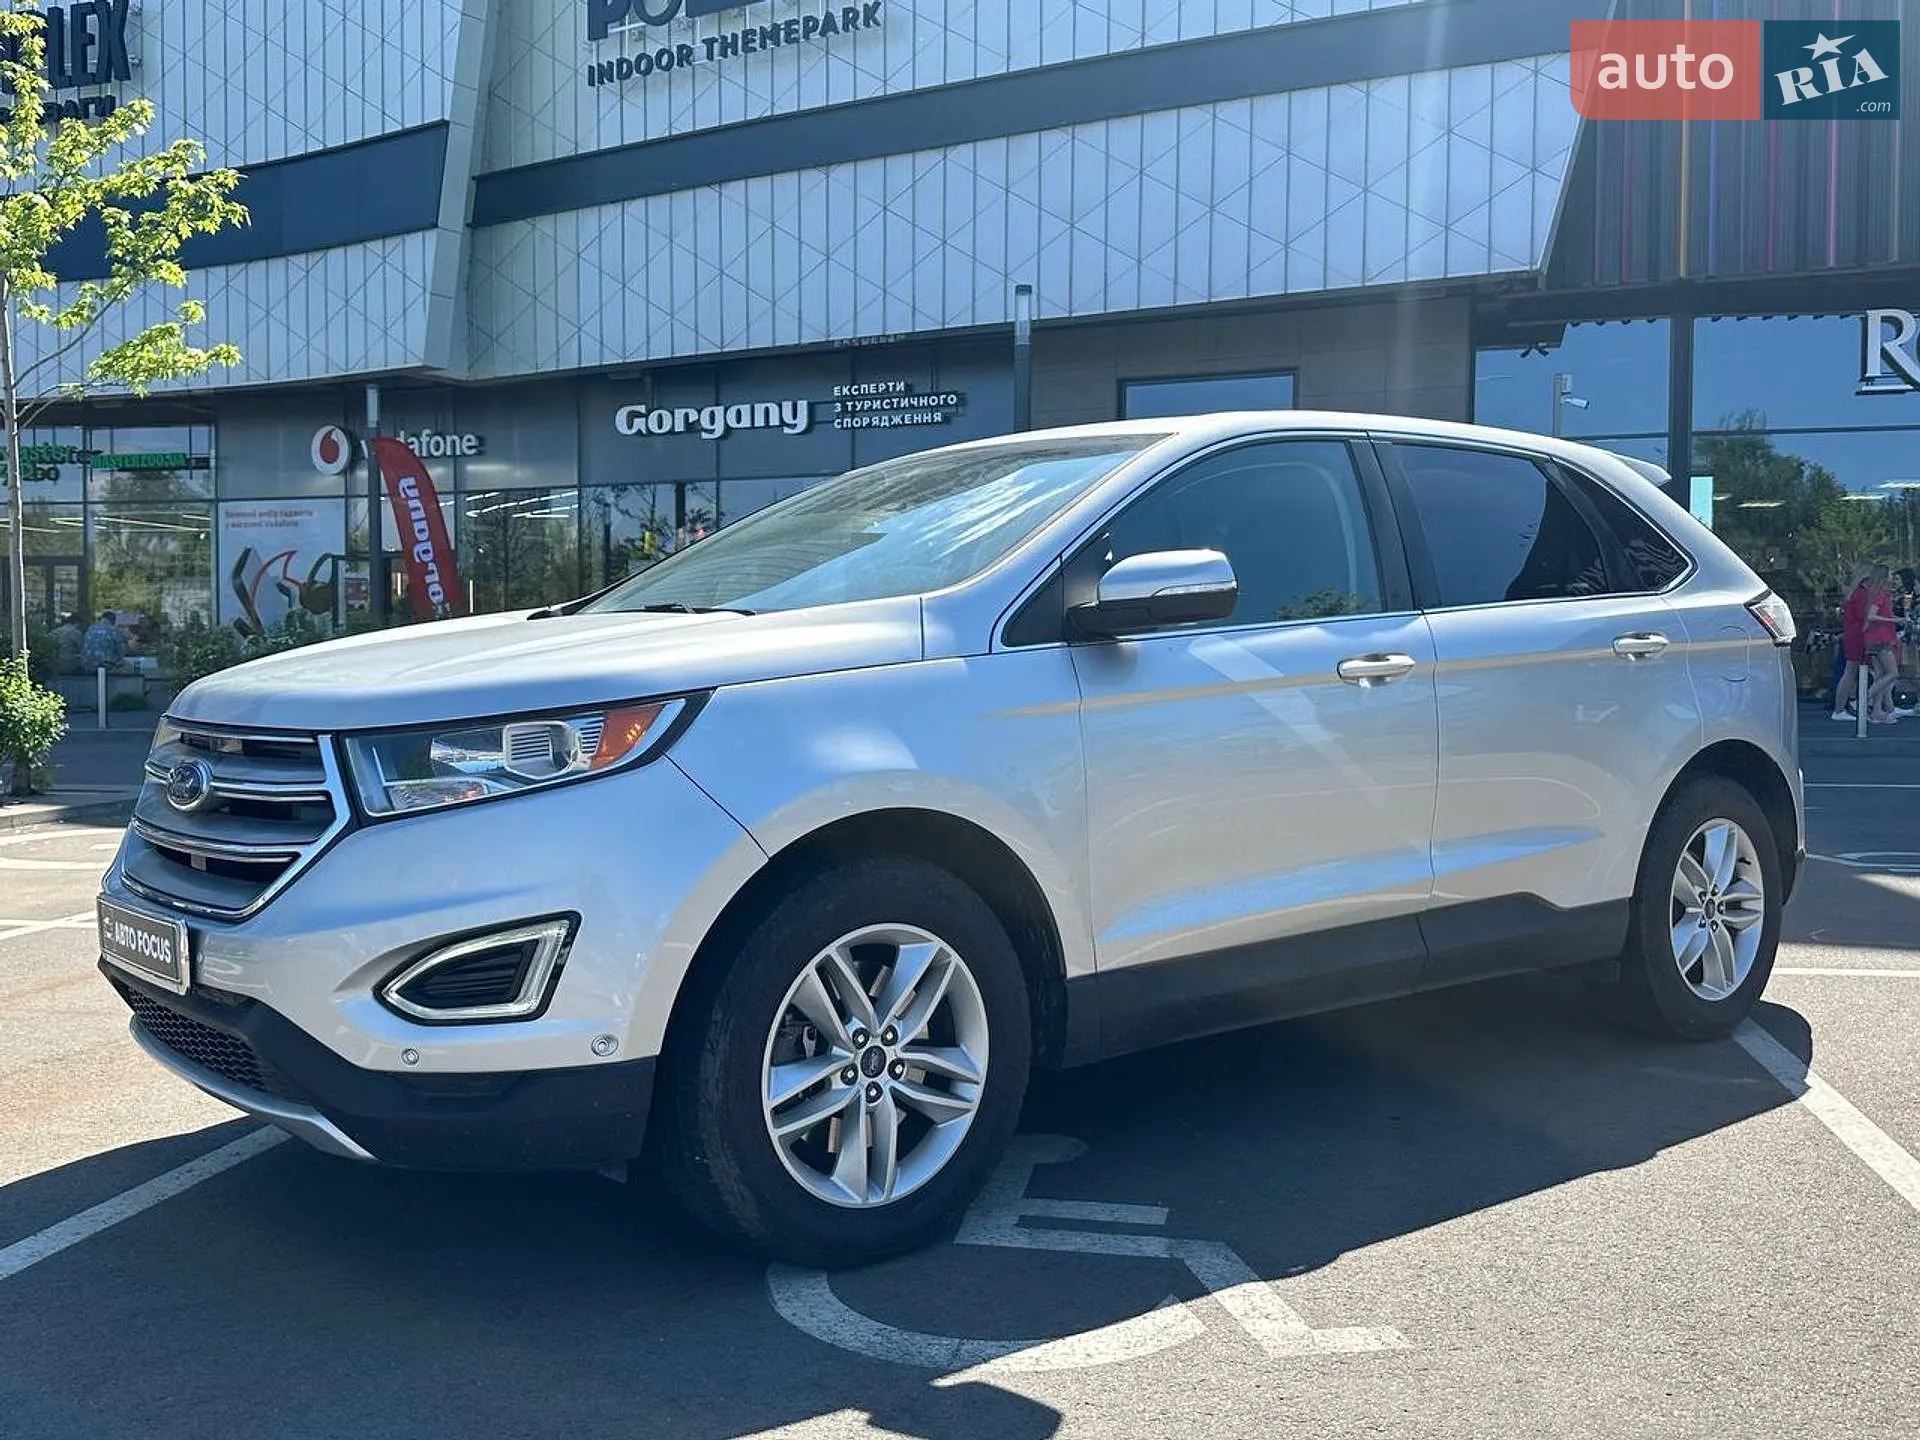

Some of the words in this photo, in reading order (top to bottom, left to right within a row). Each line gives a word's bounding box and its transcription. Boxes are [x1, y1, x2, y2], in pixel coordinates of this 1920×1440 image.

[587, 43, 693, 87] INDOOR
[702, 1, 882, 61] THEMEPARK
[1862, 308, 1920, 391] R
[833, 381, 905, 396] ЕКСПЕРТИ
[846, 394, 957, 412] ТУРИСТИЧНОГО
[615, 400, 809, 439] Gorgany
[834, 412, 942, 429] СПОРЯДЖЕННЯ
[136, 929, 172, 964] FOCUS
